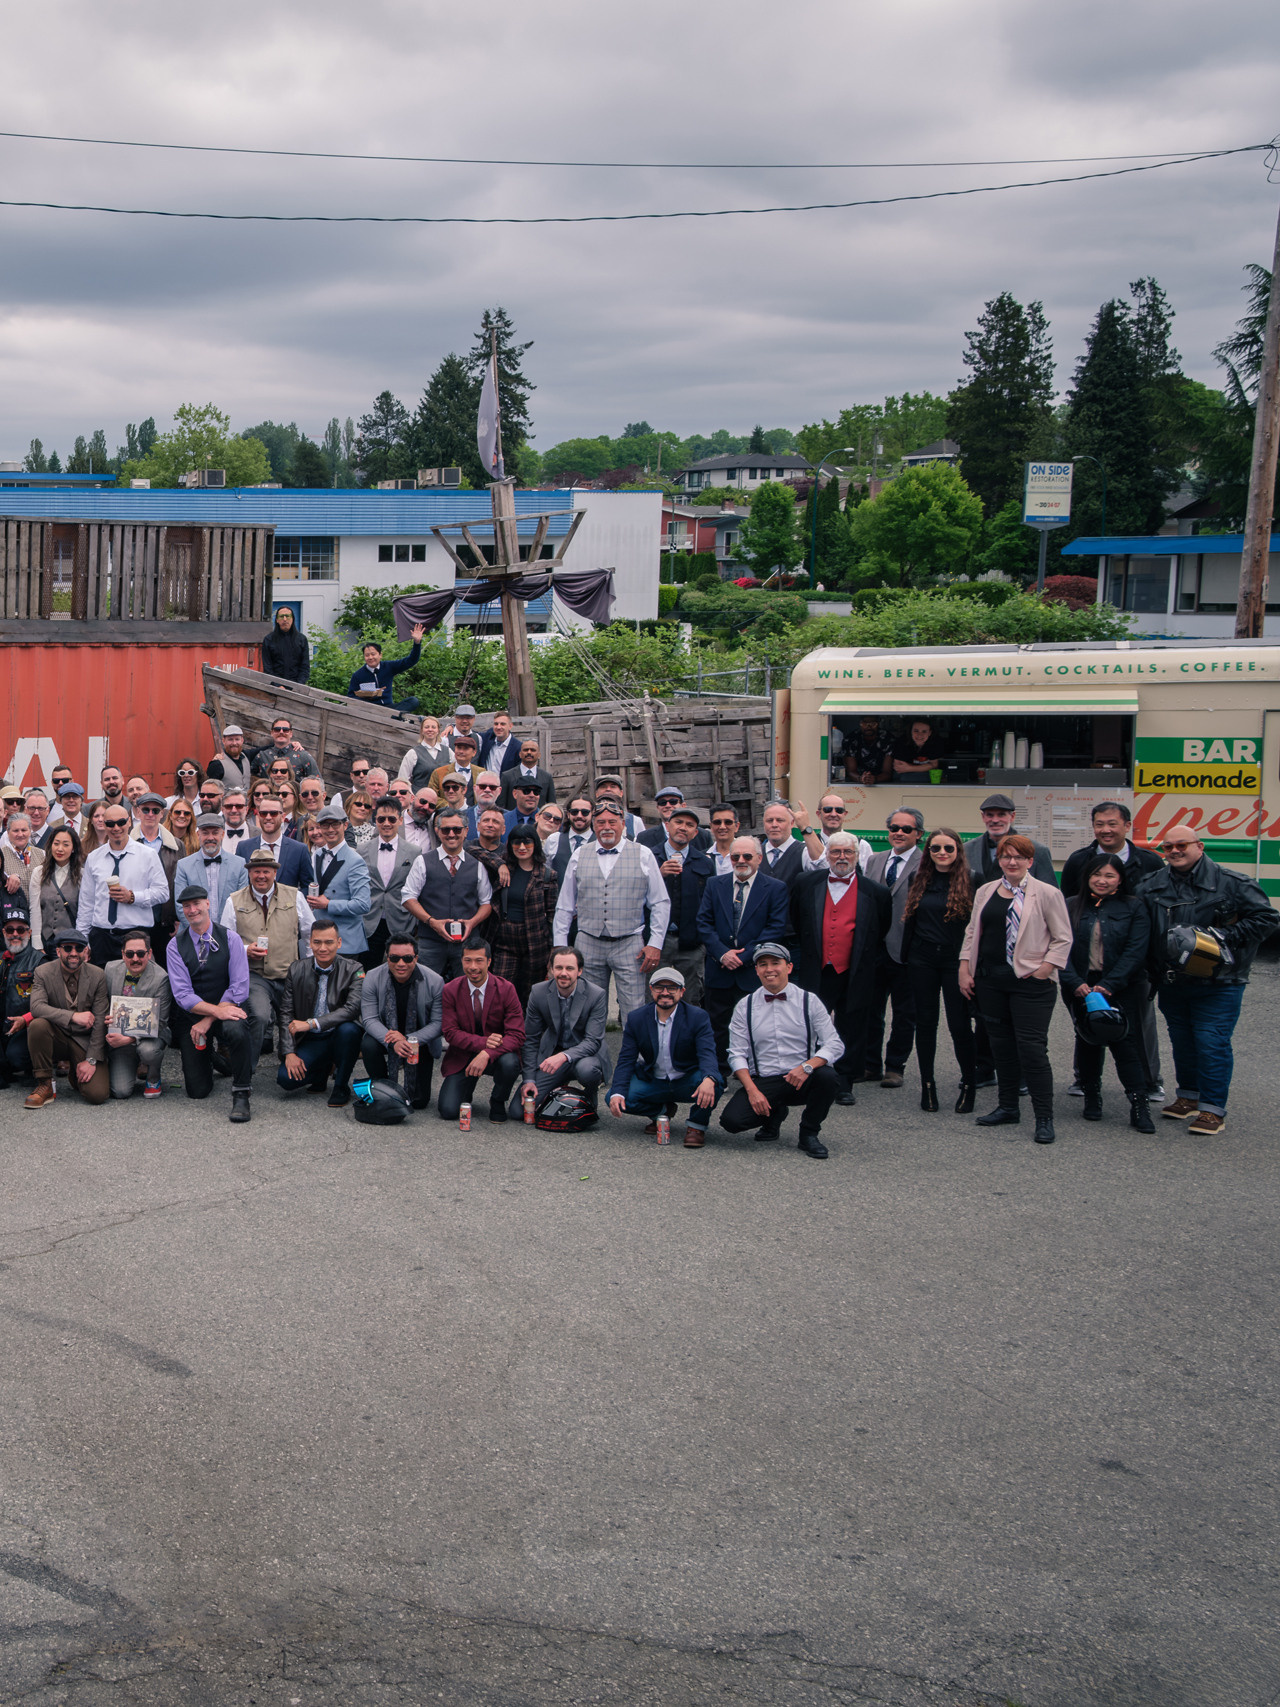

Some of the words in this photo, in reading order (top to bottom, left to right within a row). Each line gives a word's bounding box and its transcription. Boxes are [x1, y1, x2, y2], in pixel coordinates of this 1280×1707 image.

[1031, 465, 1046, 475] ON
[817, 669, 872, 679] WINE.
[883, 668, 935, 678] BEER.
[946, 666, 1032, 677] VERMUT.
[1043, 663, 1167, 676] COCKTAILS.
[1180, 661, 1266, 673] COFFEE.
[1182, 739, 1257, 763] BAR
[1138, 768, 1257, 789] Lemonade
